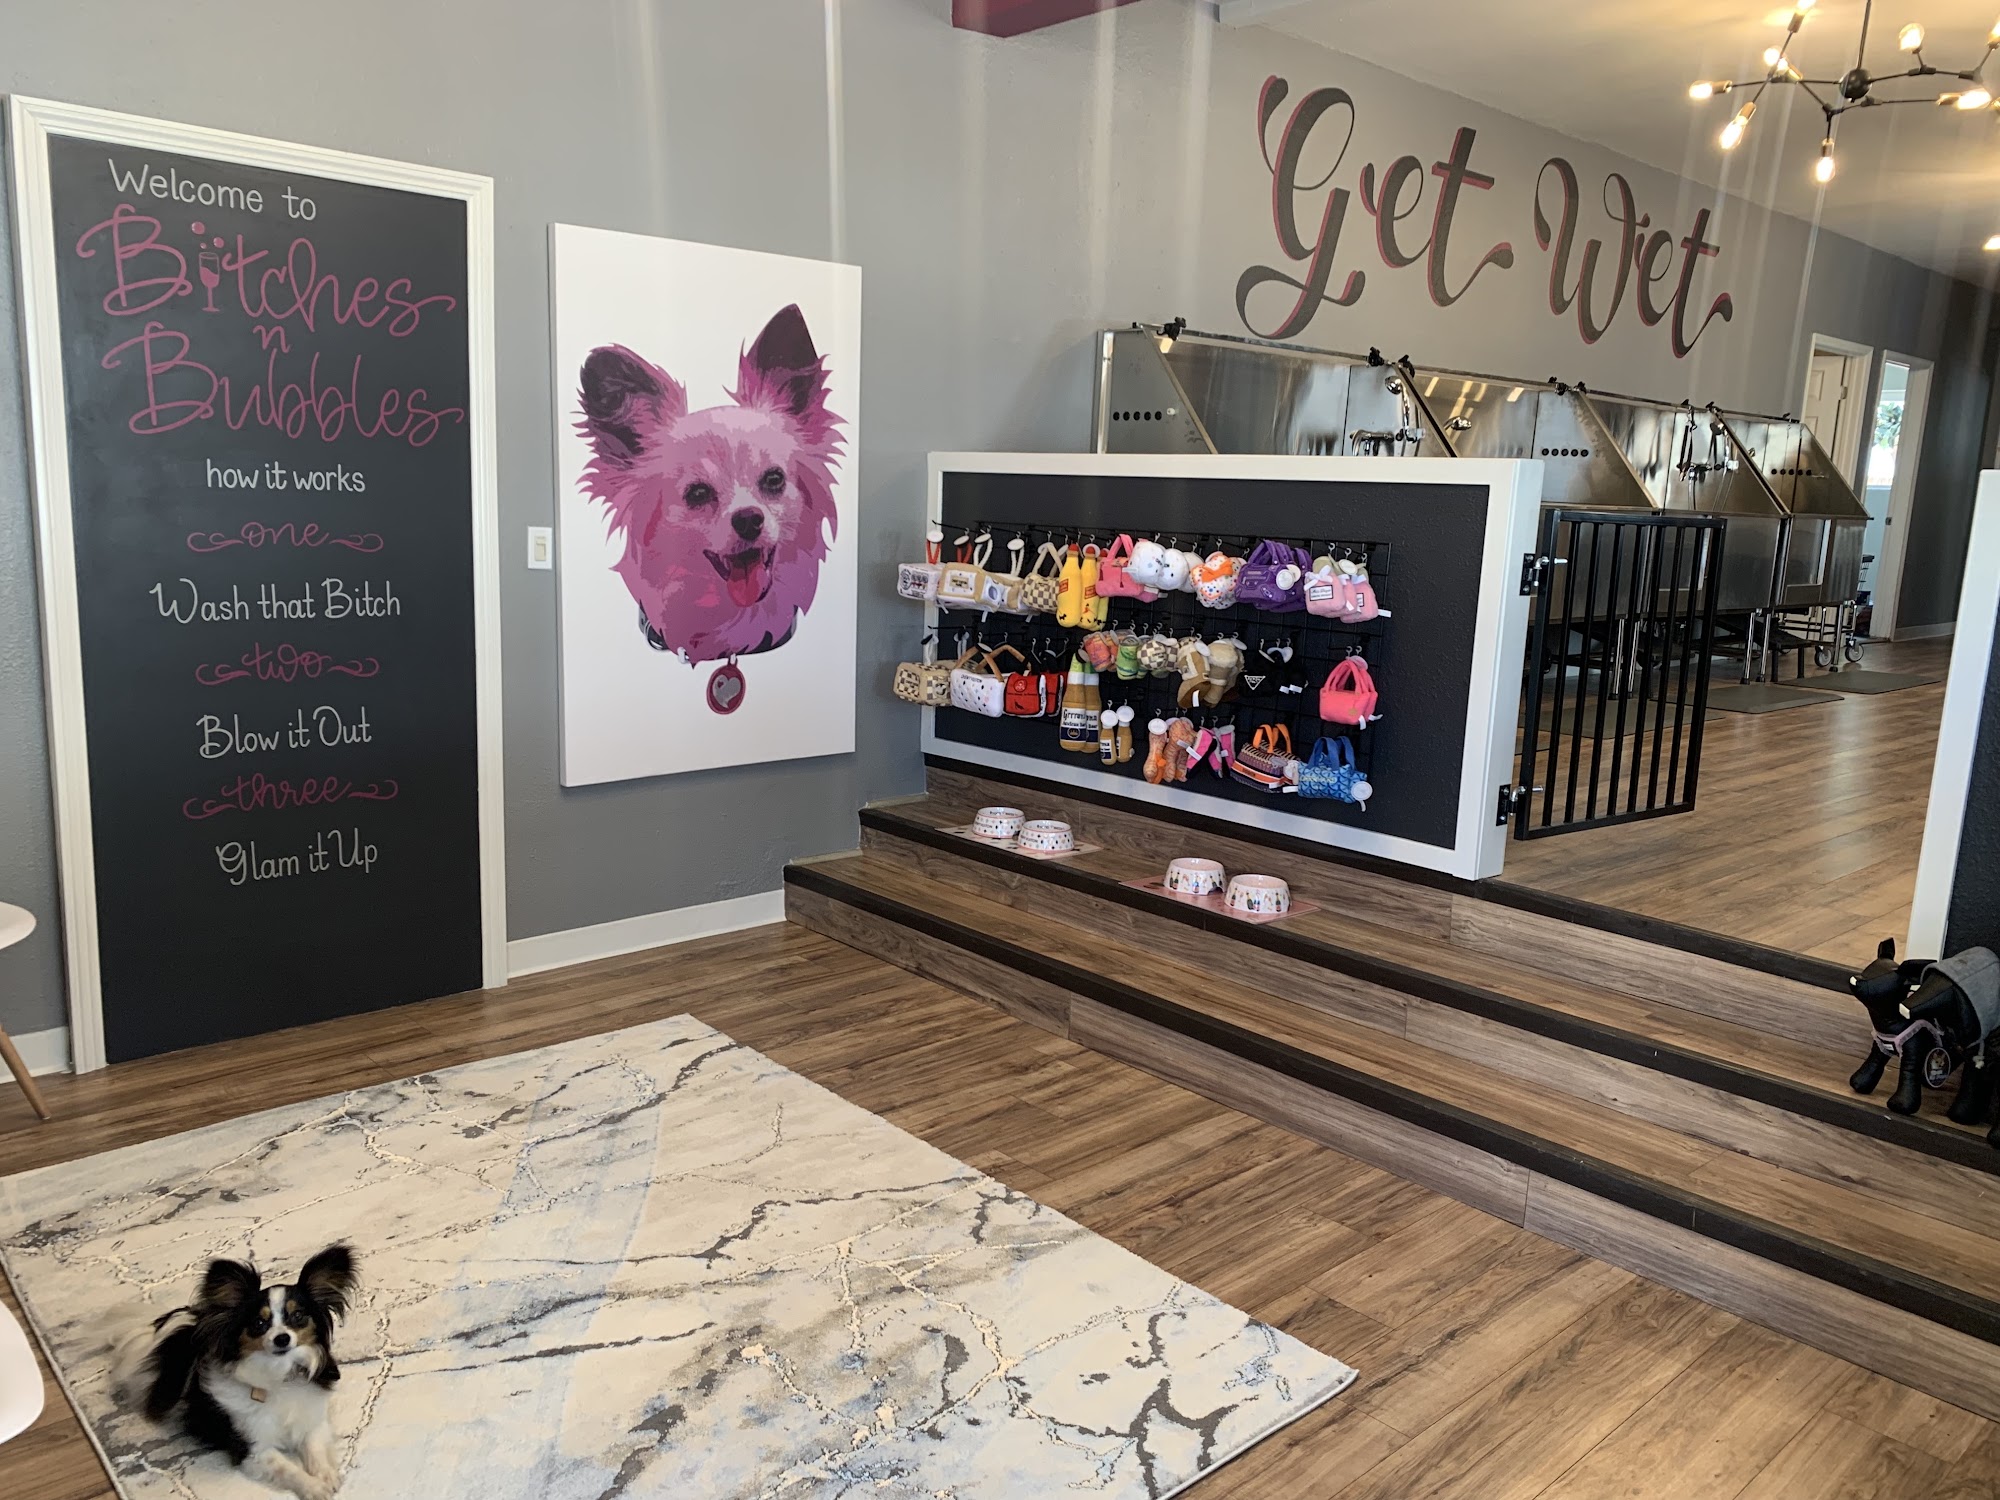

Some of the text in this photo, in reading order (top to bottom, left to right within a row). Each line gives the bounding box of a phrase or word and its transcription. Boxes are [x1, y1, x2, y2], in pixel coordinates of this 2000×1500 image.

[107, 158, 317, 222] Welcome to
[1235, 74, 1733, 359] Get Wet
[76, 203, 456, 337] Bitches
[252, 324, 291, 353] n
[101, 321, 465, 447] Bubbles
[205, 459, 366, 493] how it works
[241, 521, 330, 548] one
[149, 577, 401, 624] Wash that Bitch
[241, 642, 332, 684] two
[195, 705, 373, 759] Blow it Out
[220, 773, 353, 811] three
[215, 826, 379, 886] Glam it Up
